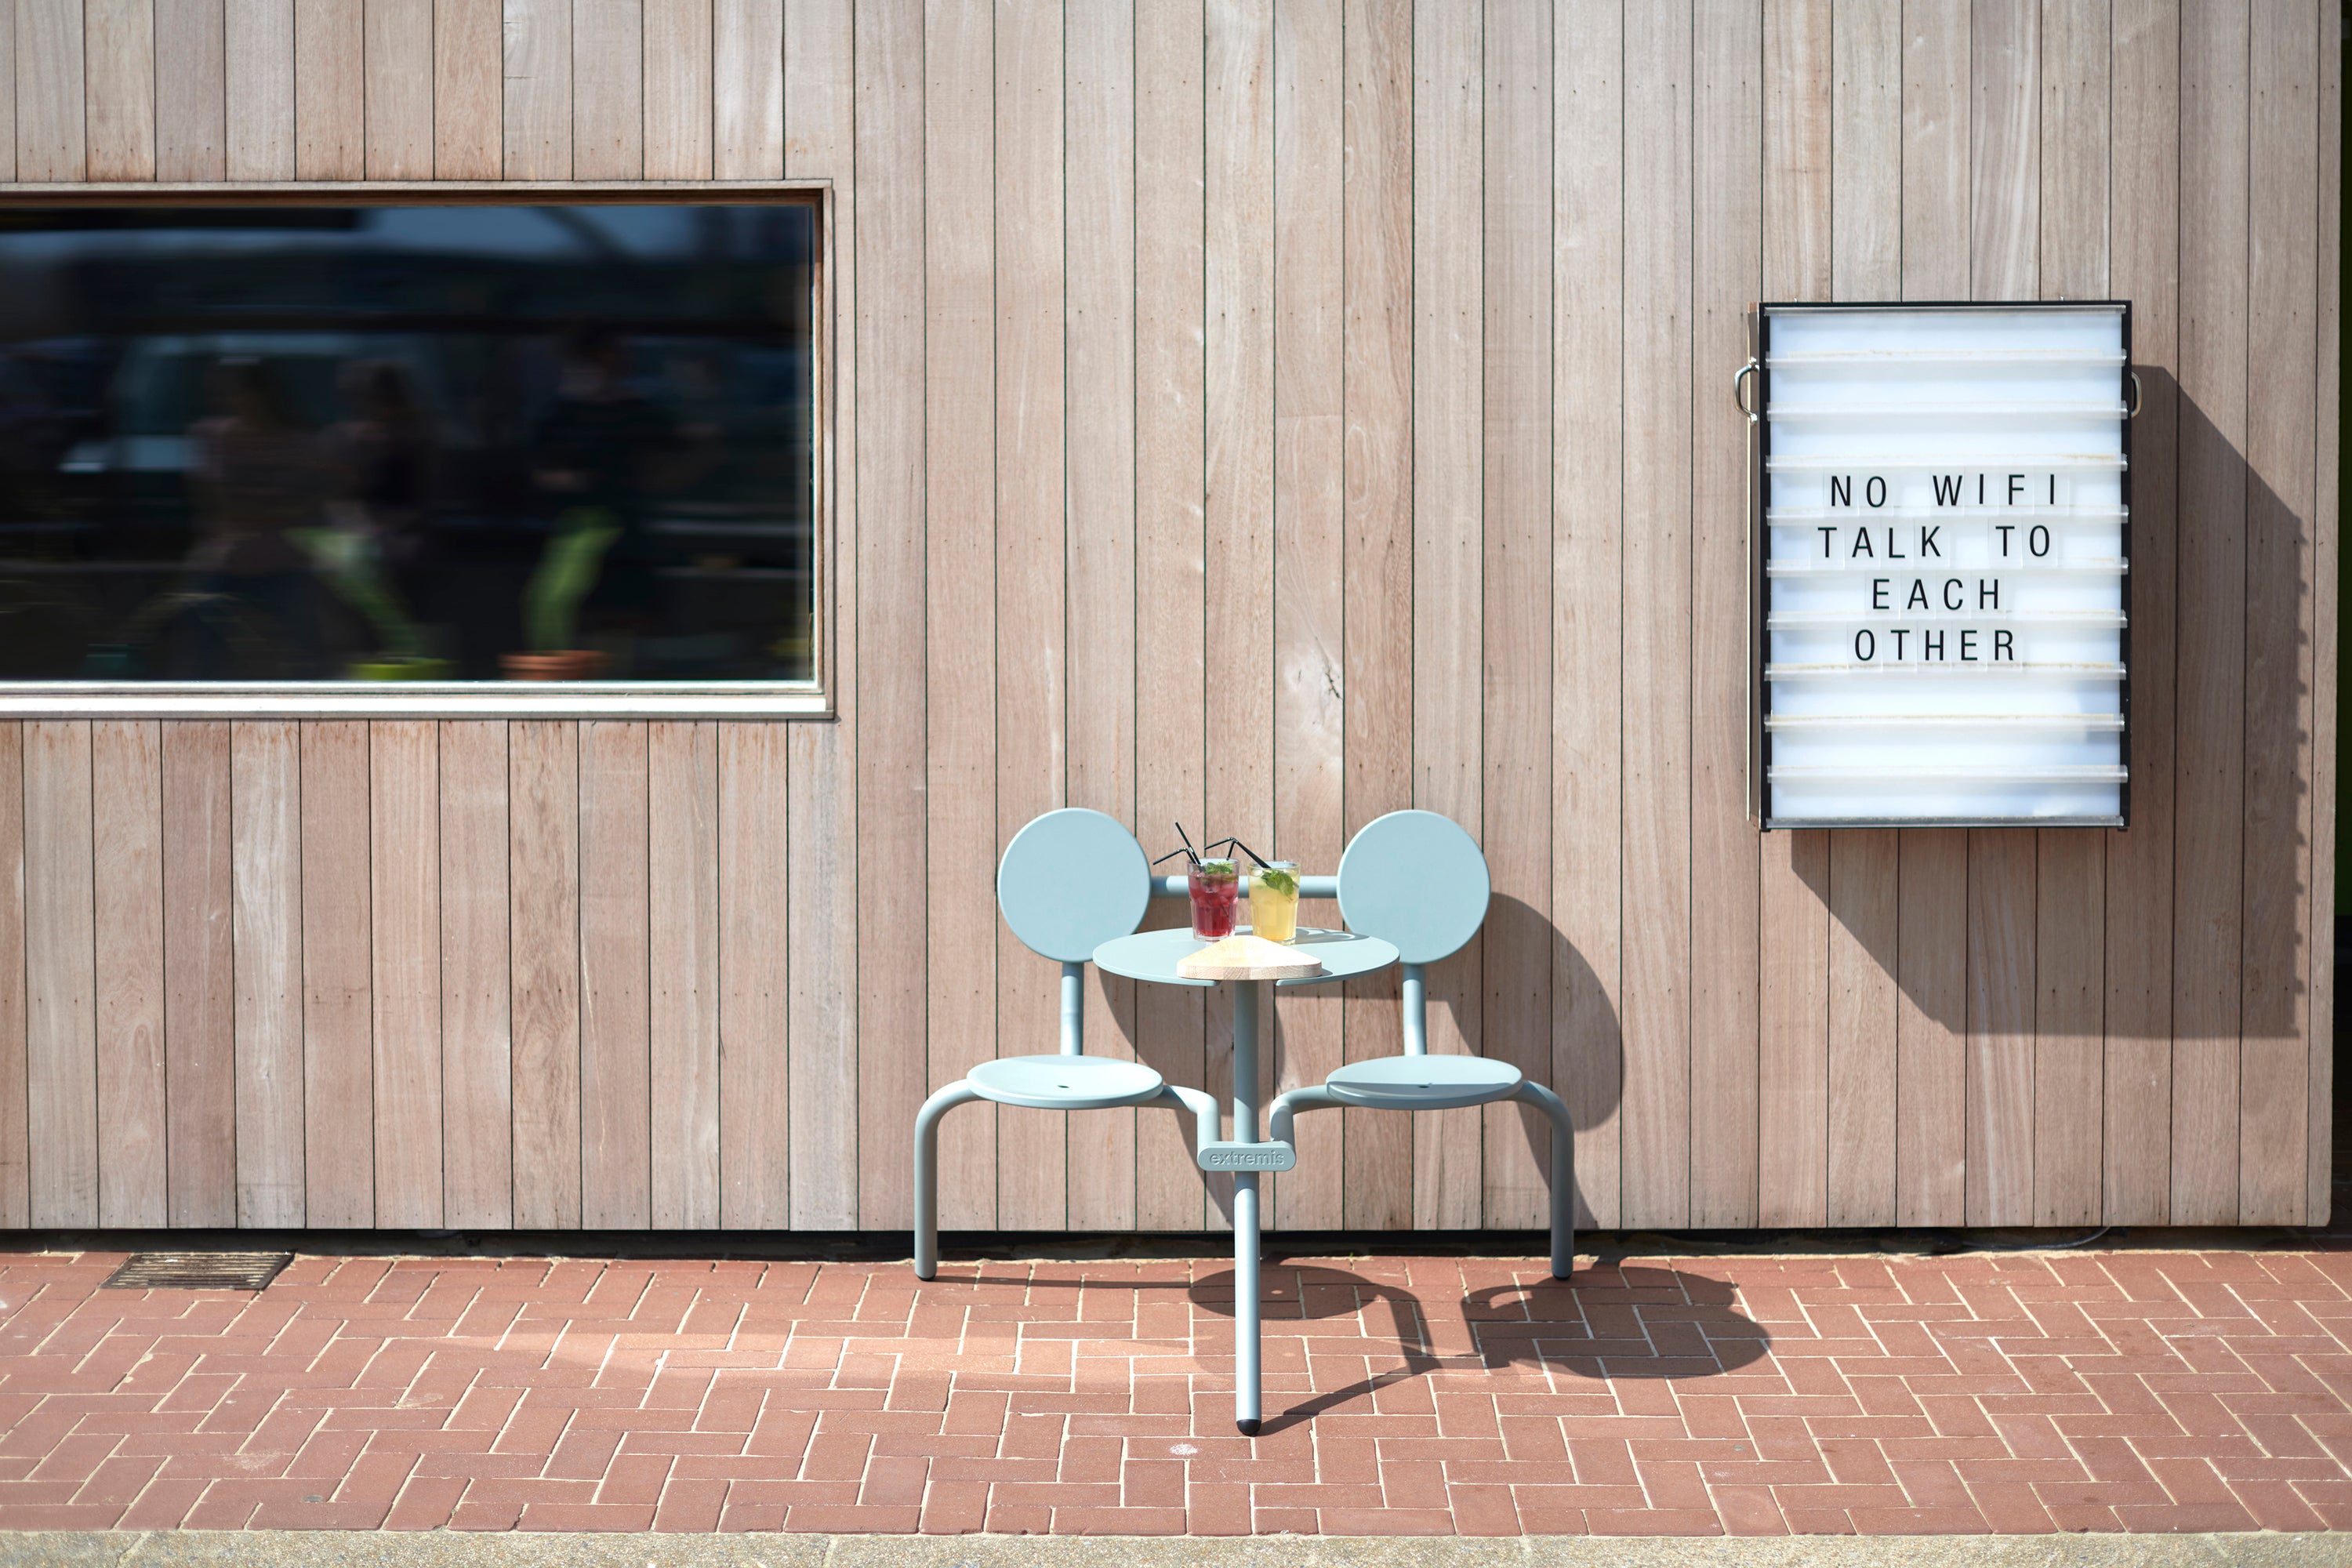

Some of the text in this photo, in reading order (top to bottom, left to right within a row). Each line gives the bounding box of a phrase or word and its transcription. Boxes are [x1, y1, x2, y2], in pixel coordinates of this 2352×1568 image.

[1831, 474, 2056, 507] NO WIFI
[1817, 524, 2050, 558] TALK TO
[1872, 579, 1999, 610] EACH
[1854, 629, 2014, 661] OTHER
[1209, 1149, 1285, 1165] extremis
